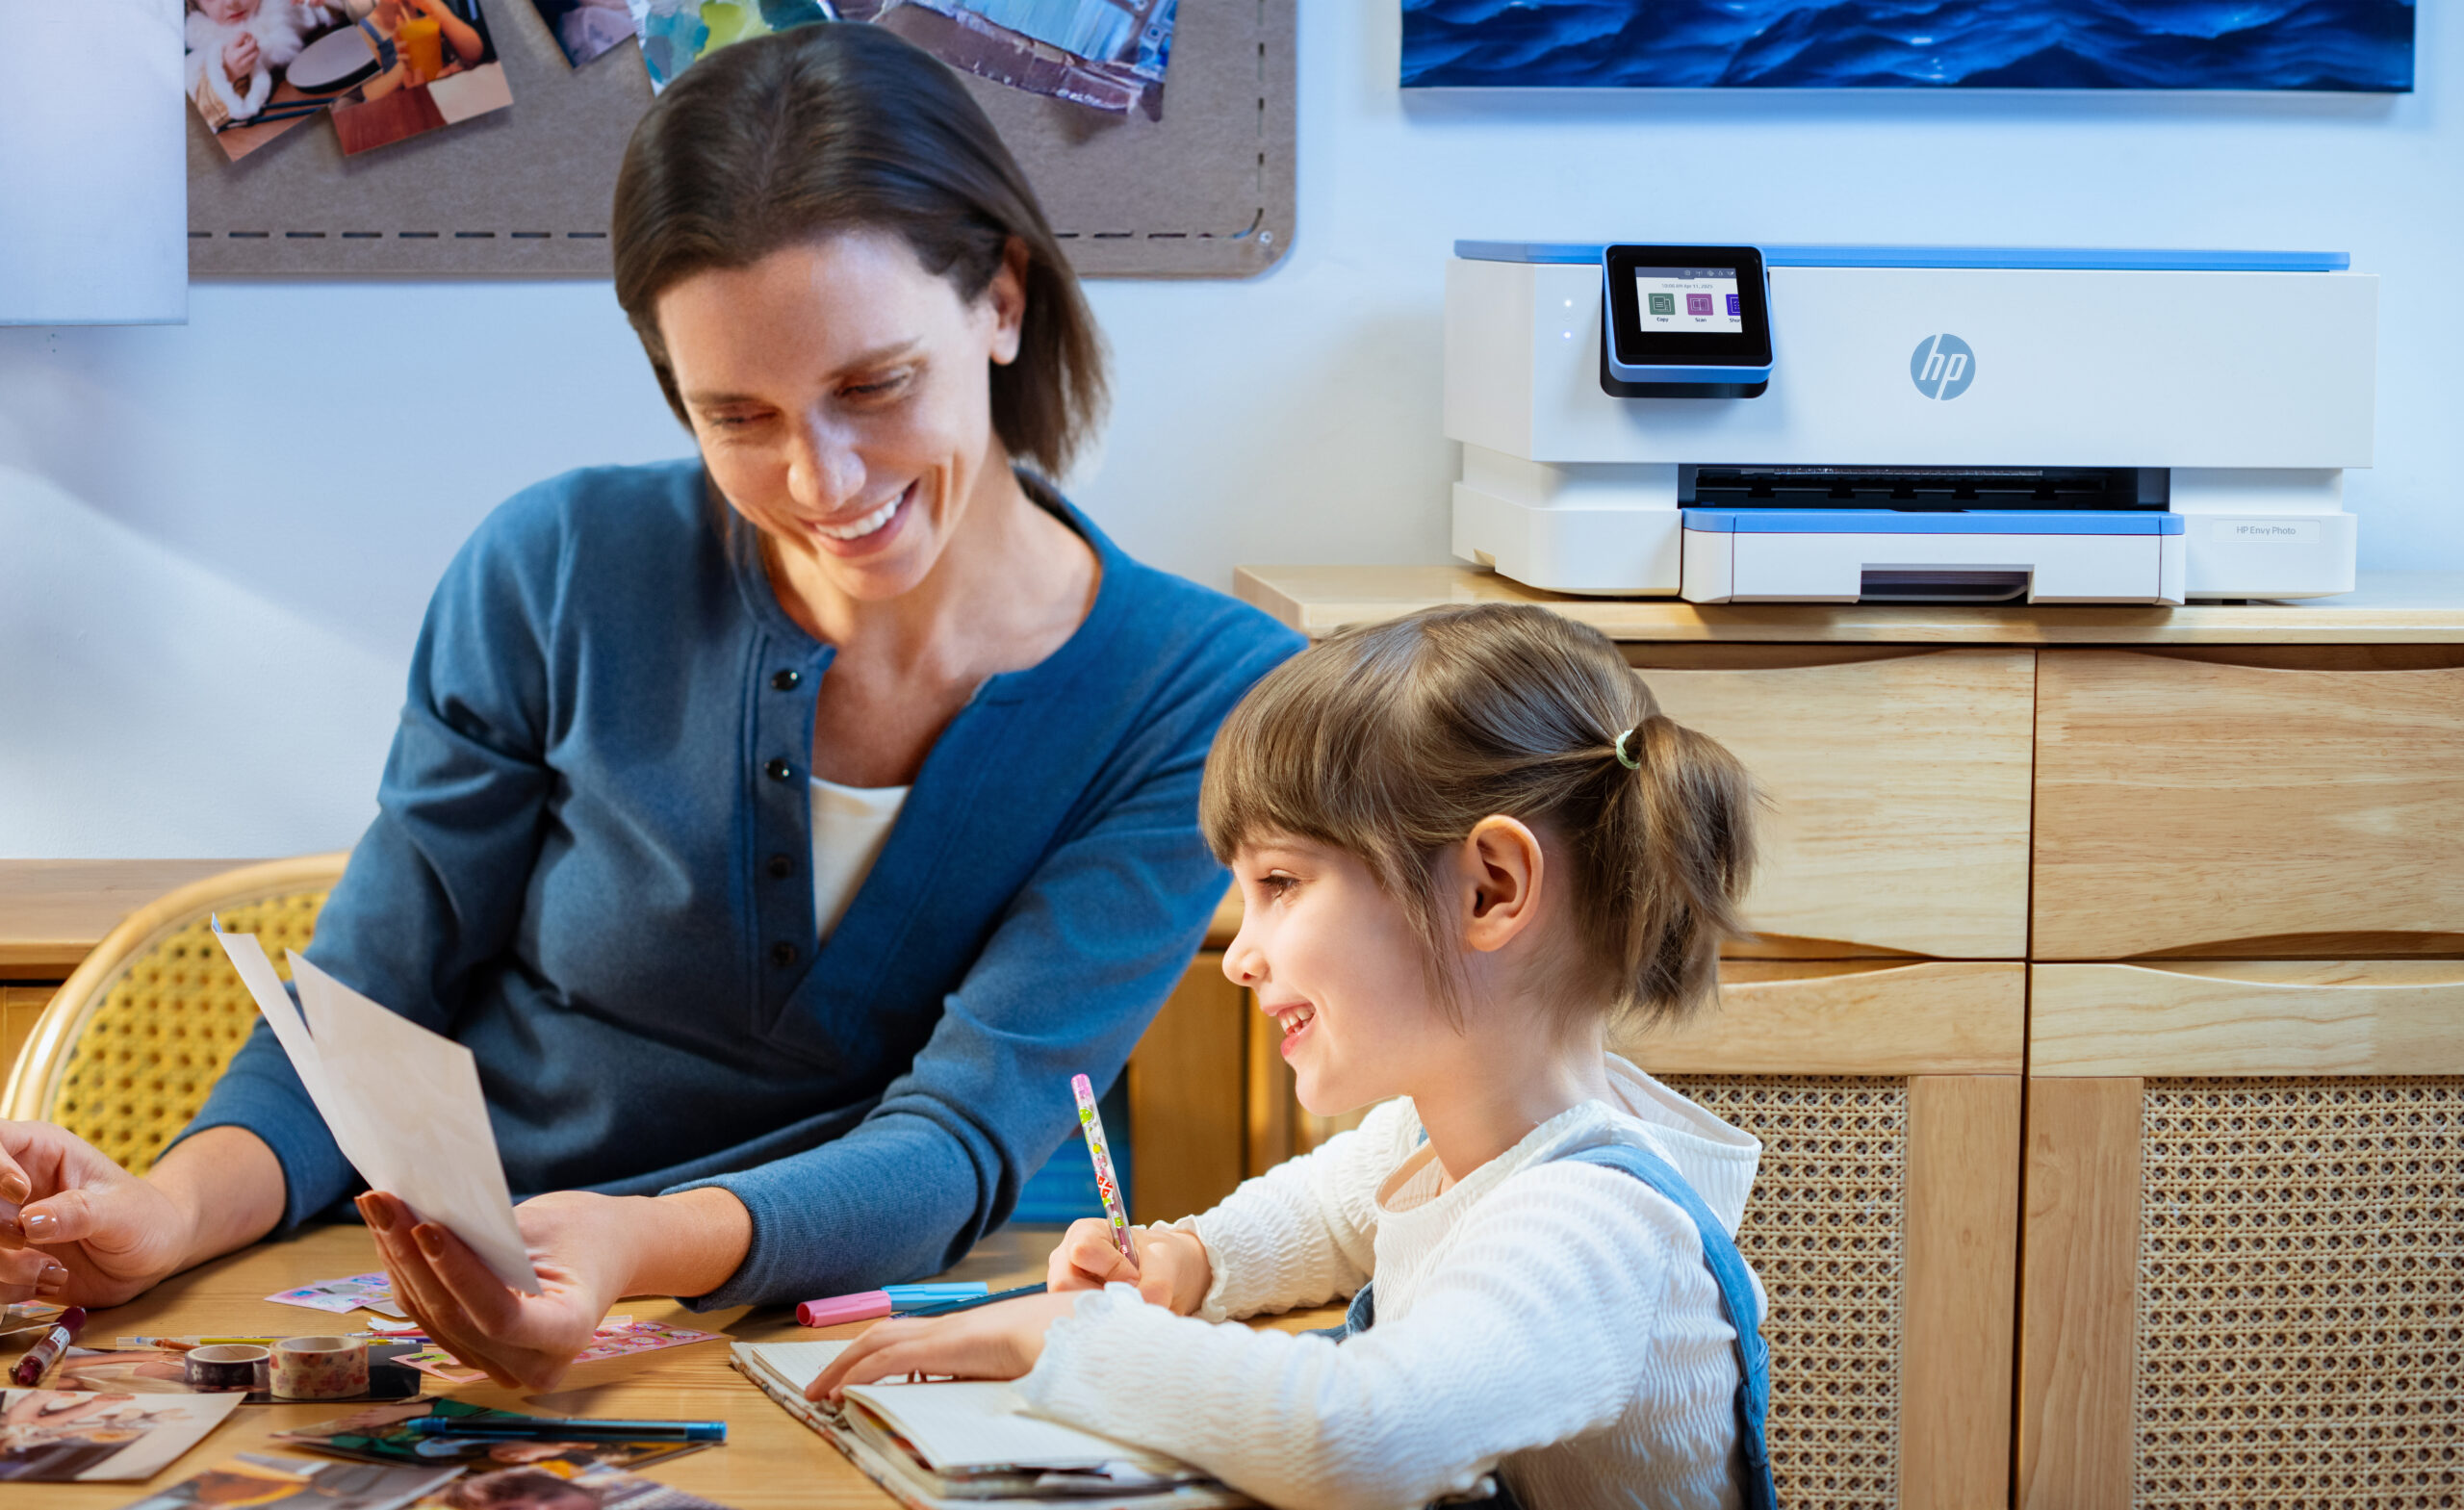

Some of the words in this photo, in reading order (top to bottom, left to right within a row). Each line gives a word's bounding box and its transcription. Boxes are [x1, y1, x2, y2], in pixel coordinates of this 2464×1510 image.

[1918, 333, 1969, 401] hp
[2236, 525, 2249, 534] HP
[2249, 525, 2271, 535] Envy
[2272, 525, 2297, 535] Photo
